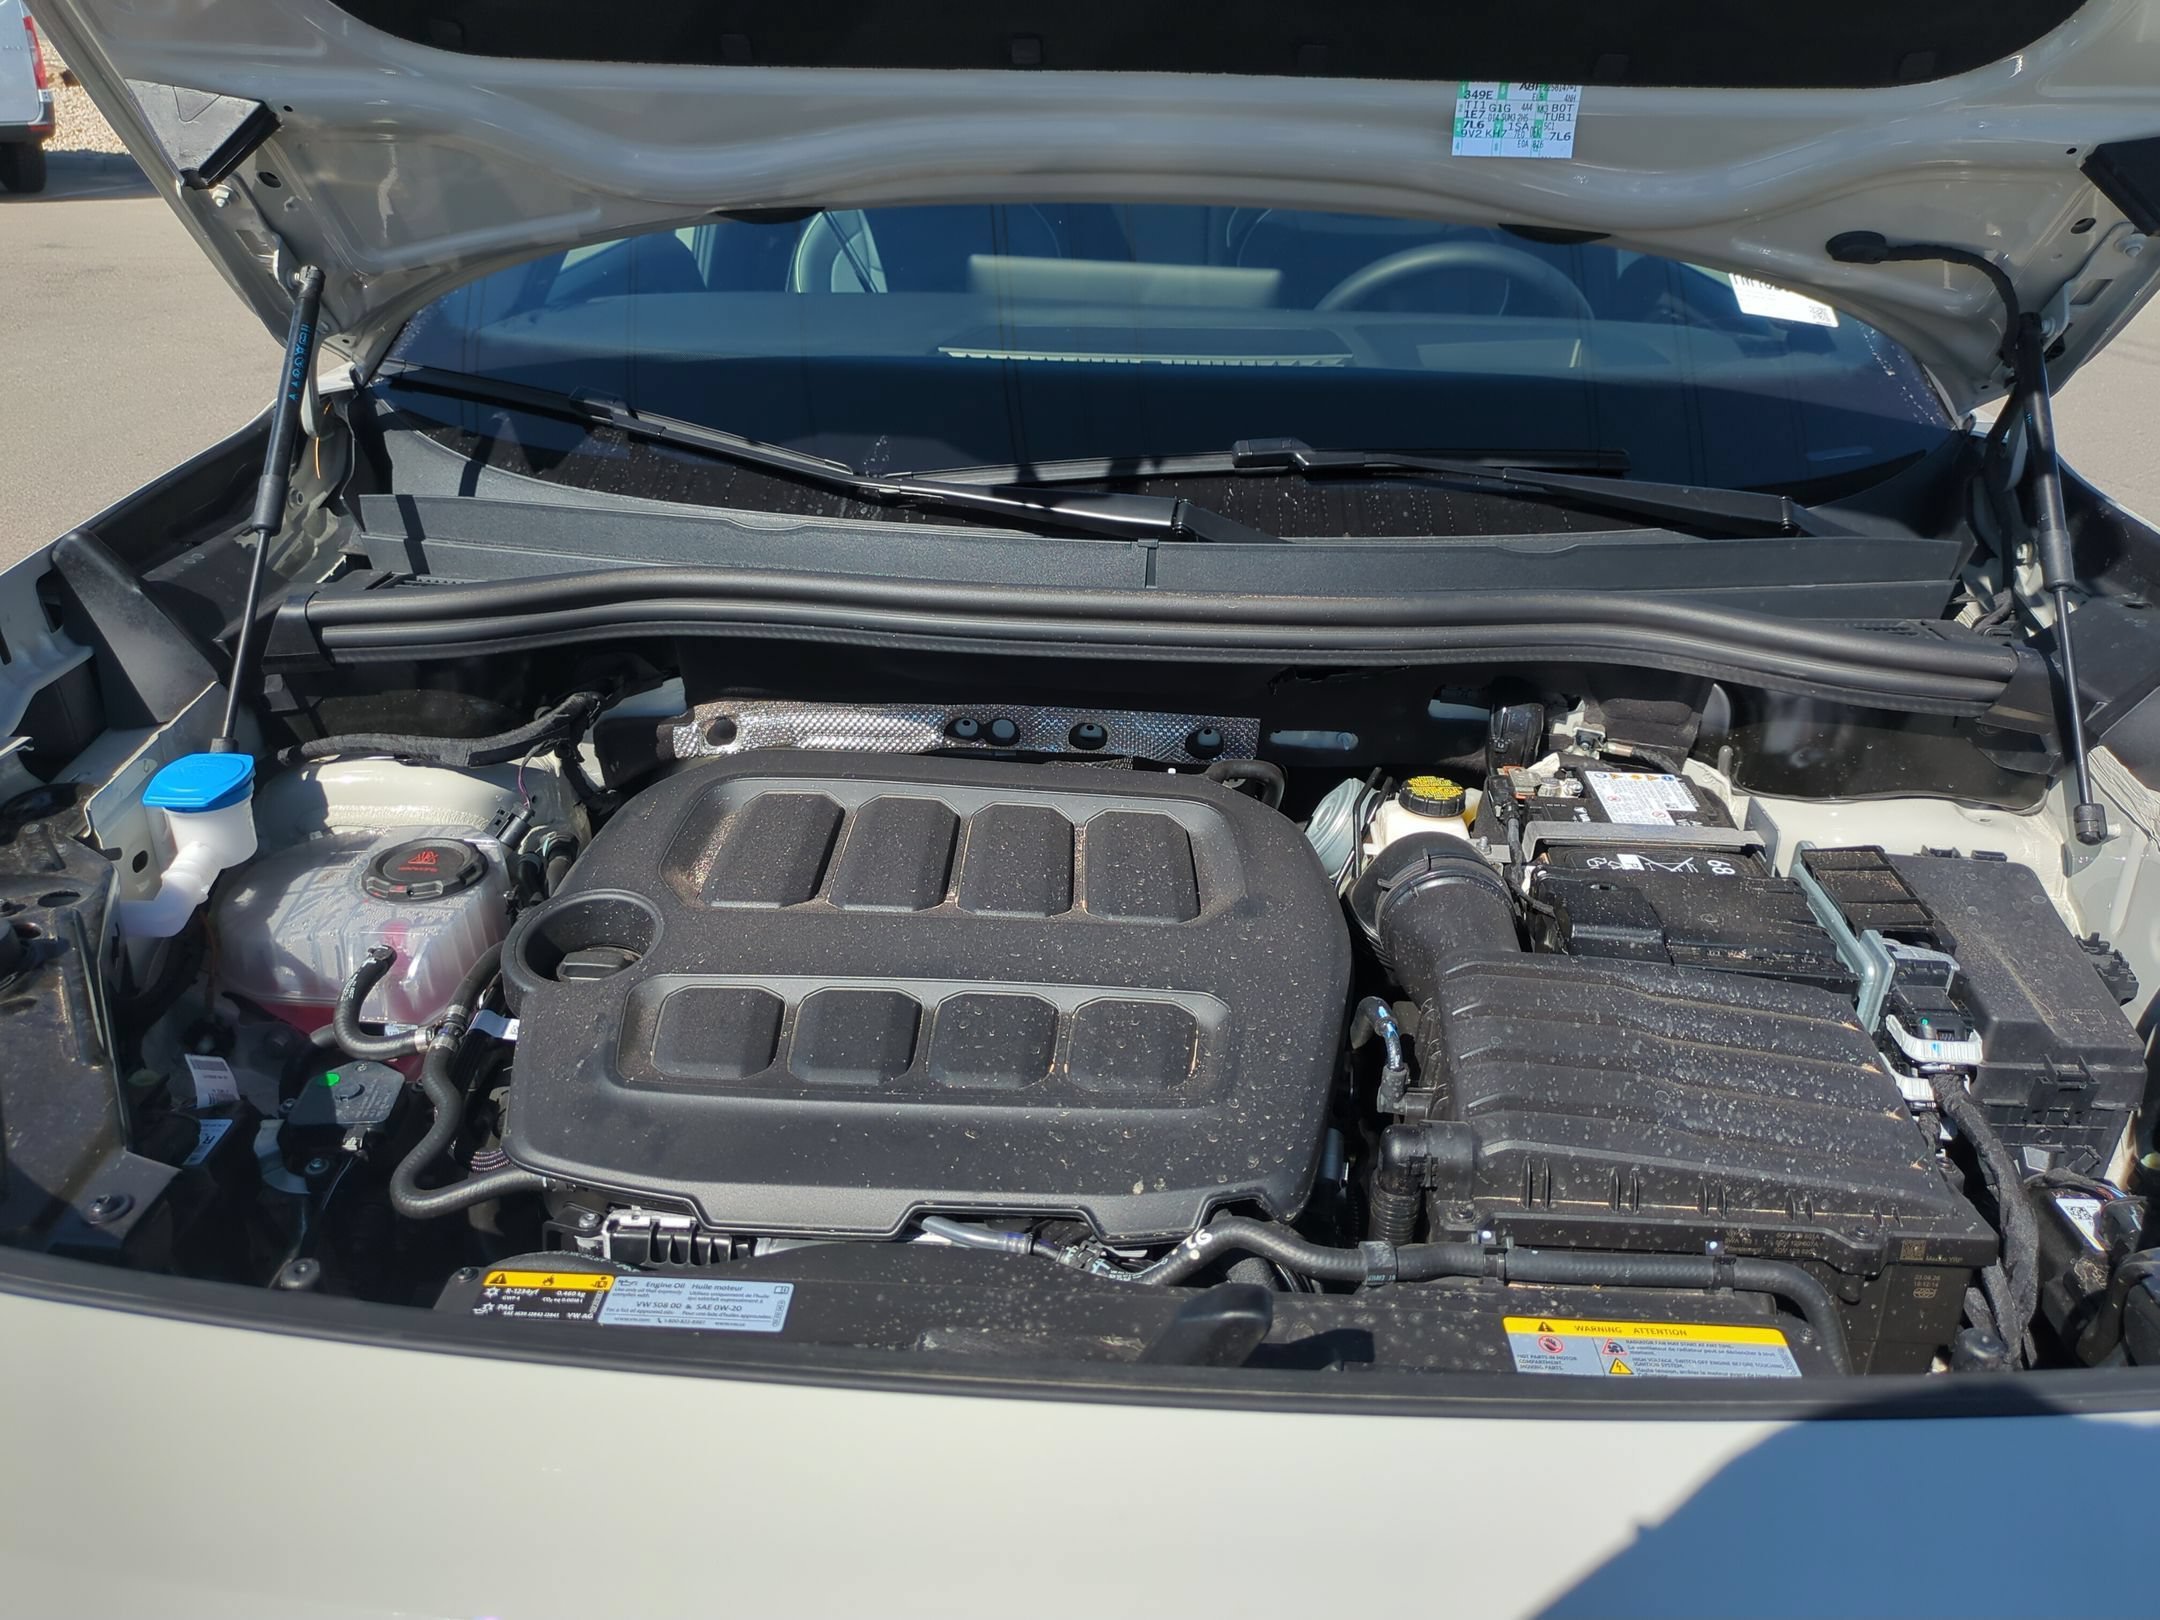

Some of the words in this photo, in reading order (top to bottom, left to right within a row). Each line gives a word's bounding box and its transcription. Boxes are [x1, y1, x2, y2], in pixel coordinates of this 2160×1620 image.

[1464, 90, 1494, 99] 349E
[1489, 104, 1511, 112] G1G
[1464, 110, 1486, 119] 1E7
[1463, 120, 1484, 129] 7L6
[1550, 132, 1571, 141] 7L6
[1574, 1325, 1622, 1333] WARNING
[1633, 1327, 1687, 1336] ATTENTION
